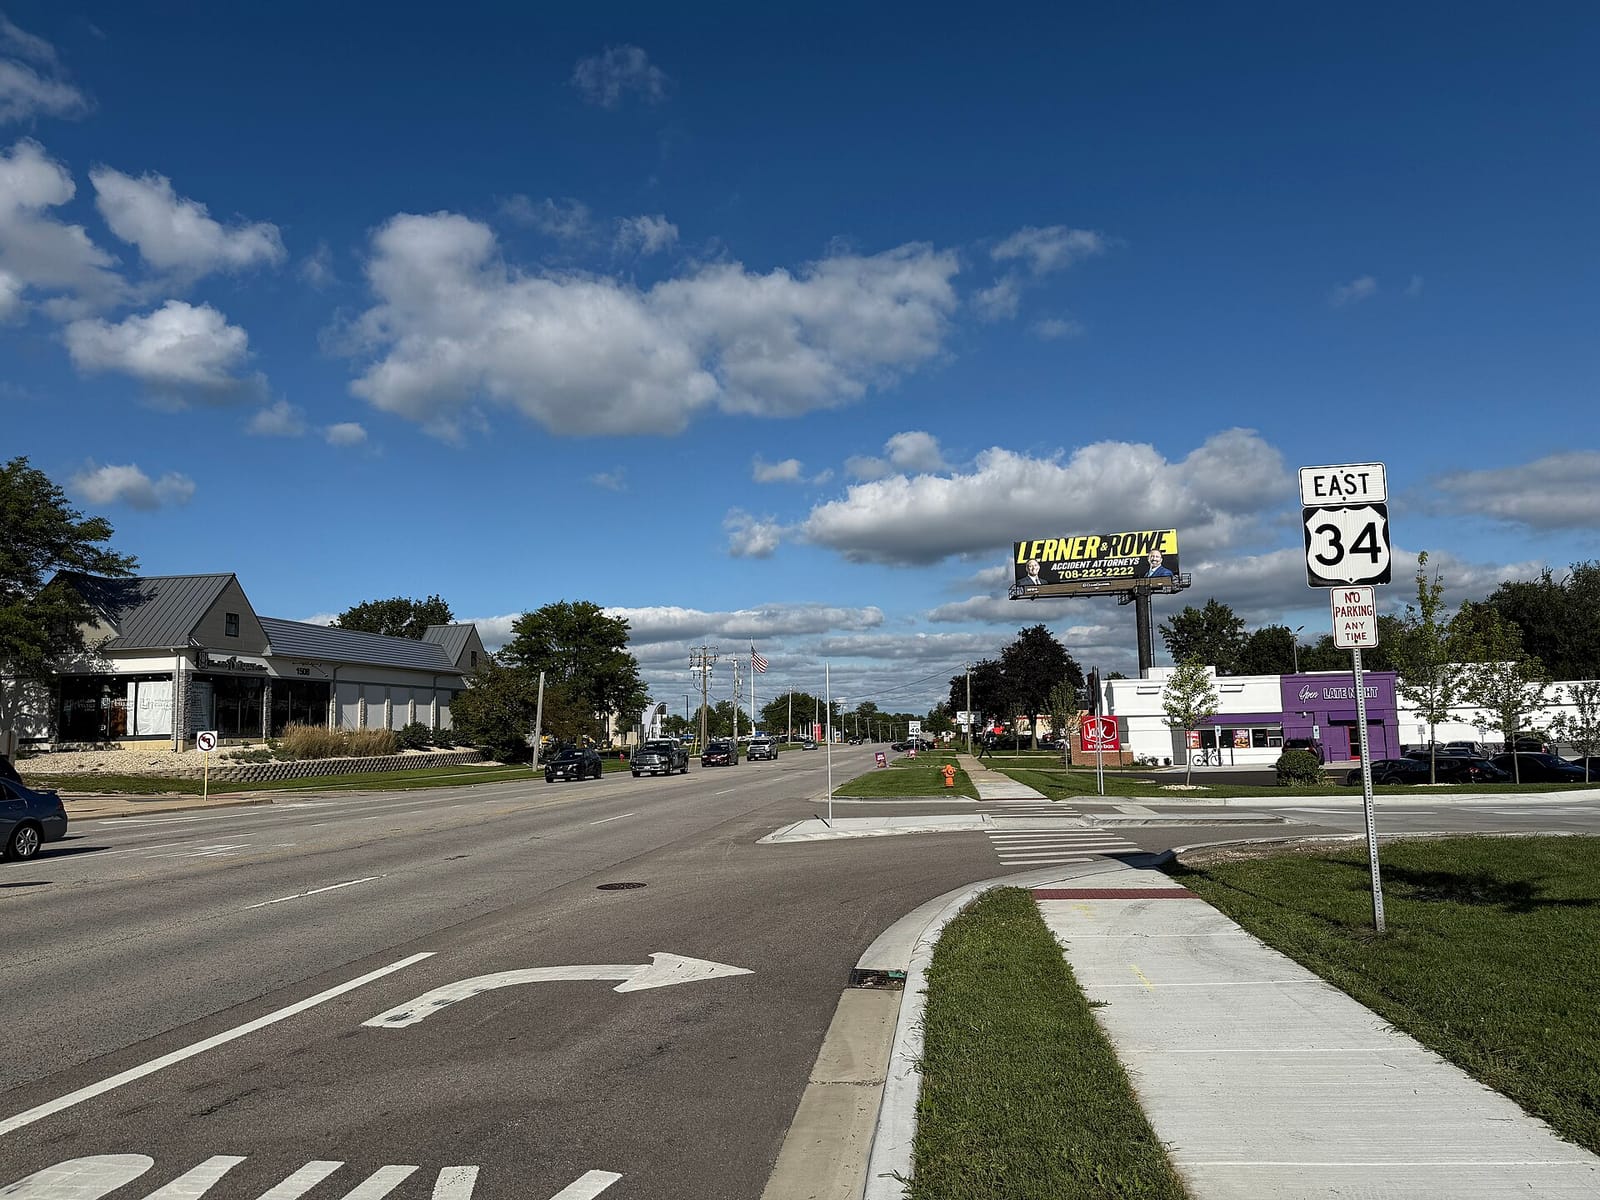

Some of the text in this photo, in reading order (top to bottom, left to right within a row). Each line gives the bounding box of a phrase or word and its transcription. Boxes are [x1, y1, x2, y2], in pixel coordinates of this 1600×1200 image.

[1314, 473, 1369, 496] EAST
[1017, 531, 1171, 564] LERNER & ROWE
[1315, 522, 1381, 566] 34
[1051, 557, 1140, 570] ACCIDENT ATTORNEYS
[1058, 567, 1134, 579] 708-222-2222
[1344, 592, 1360, 603] NO
[1335, 605, 1373, 617] PARKING
[1345, 621, 1365, 630] ANY
[1345, 632, 1367, 640] TIME
[1322, 688, 1347, 700] LATE
[1348, 686, 1378, 699] NHT
[1087, 720, 1114, 738] Jak
